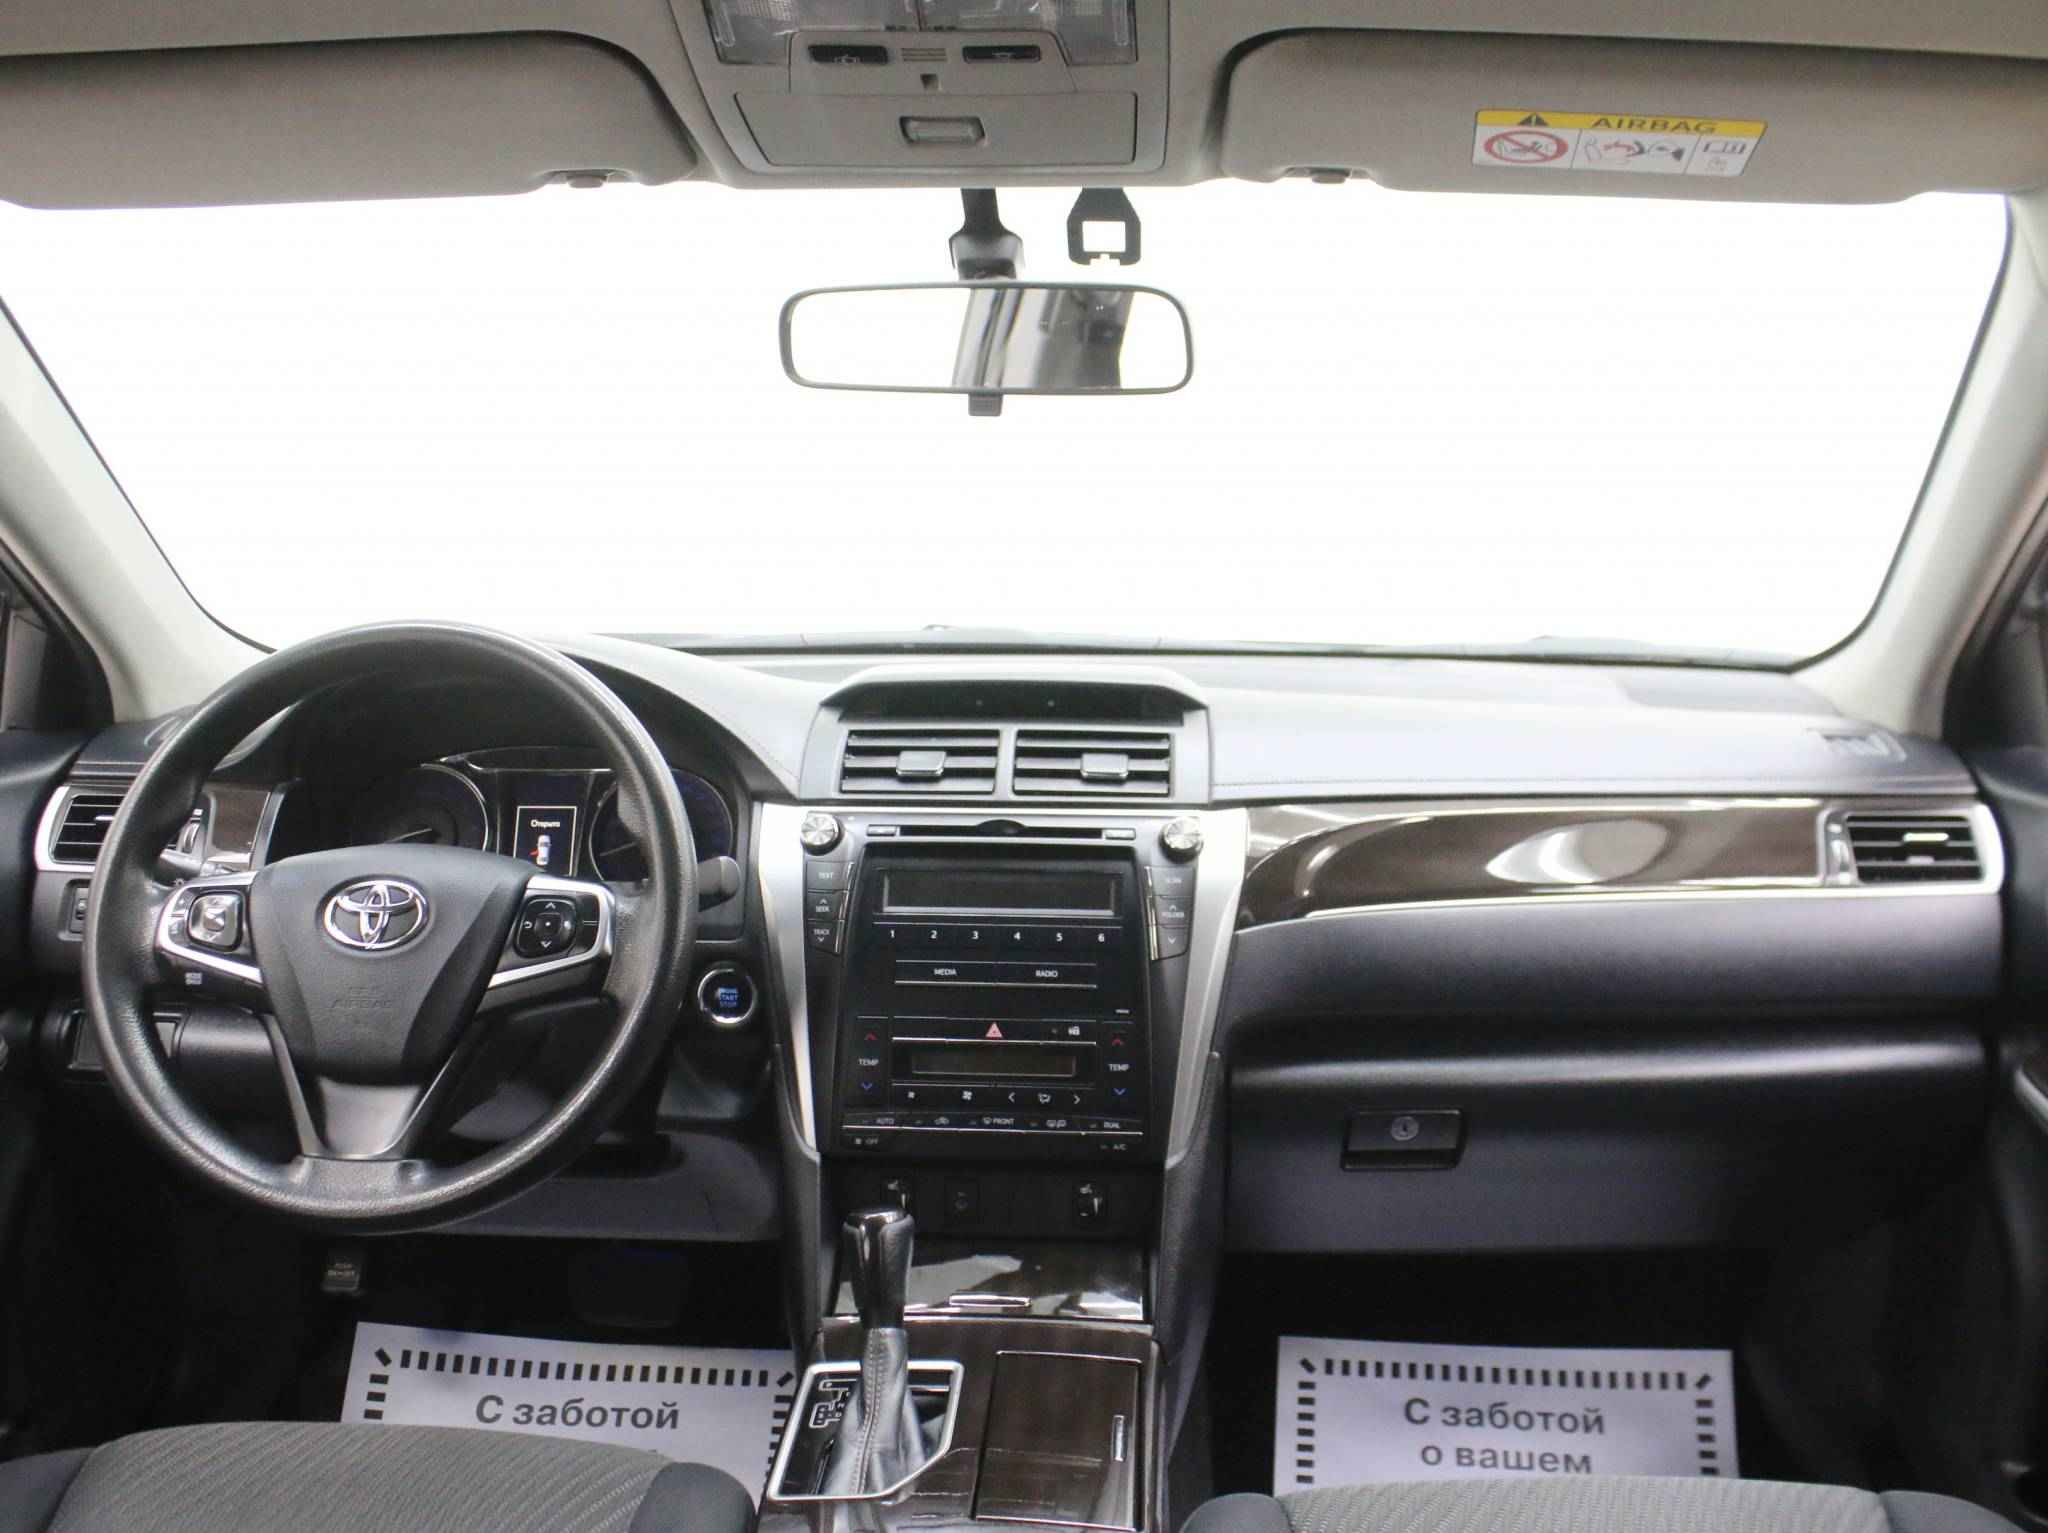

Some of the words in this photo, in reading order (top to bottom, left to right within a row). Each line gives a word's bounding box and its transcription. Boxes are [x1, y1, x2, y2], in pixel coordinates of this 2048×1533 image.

[1591, 116, 1716, 134] AIRBAG
[889, 929, 896, 939] 1
[930, 930, 938, 940] 2
[972, 931, 980, 940] 3
[1013, 931, 1022, 941] 4
[1055, 932, 1064, 942] 5
[1098, 933, 1106, 943] 6
[933, 968, 958, 977] MEDIA
[1035, 969, 1059, 978] RADIO
[858, 1058, 880, 1067] TEMP
[1108, 1063, 1130, 1072] TEMP
[992, 1117, 1015, 1126] FRONT
[475, 1394, 504, 1424] С
[512, 1398, 680, 1430] заботой
[1403, 1397, 1431, 1426] С
[1441, 1401, 1606, 1435] заботой
[1420, 1443, 1443, 1467] о
[1455, 1446, 1593, 1475] вашем
